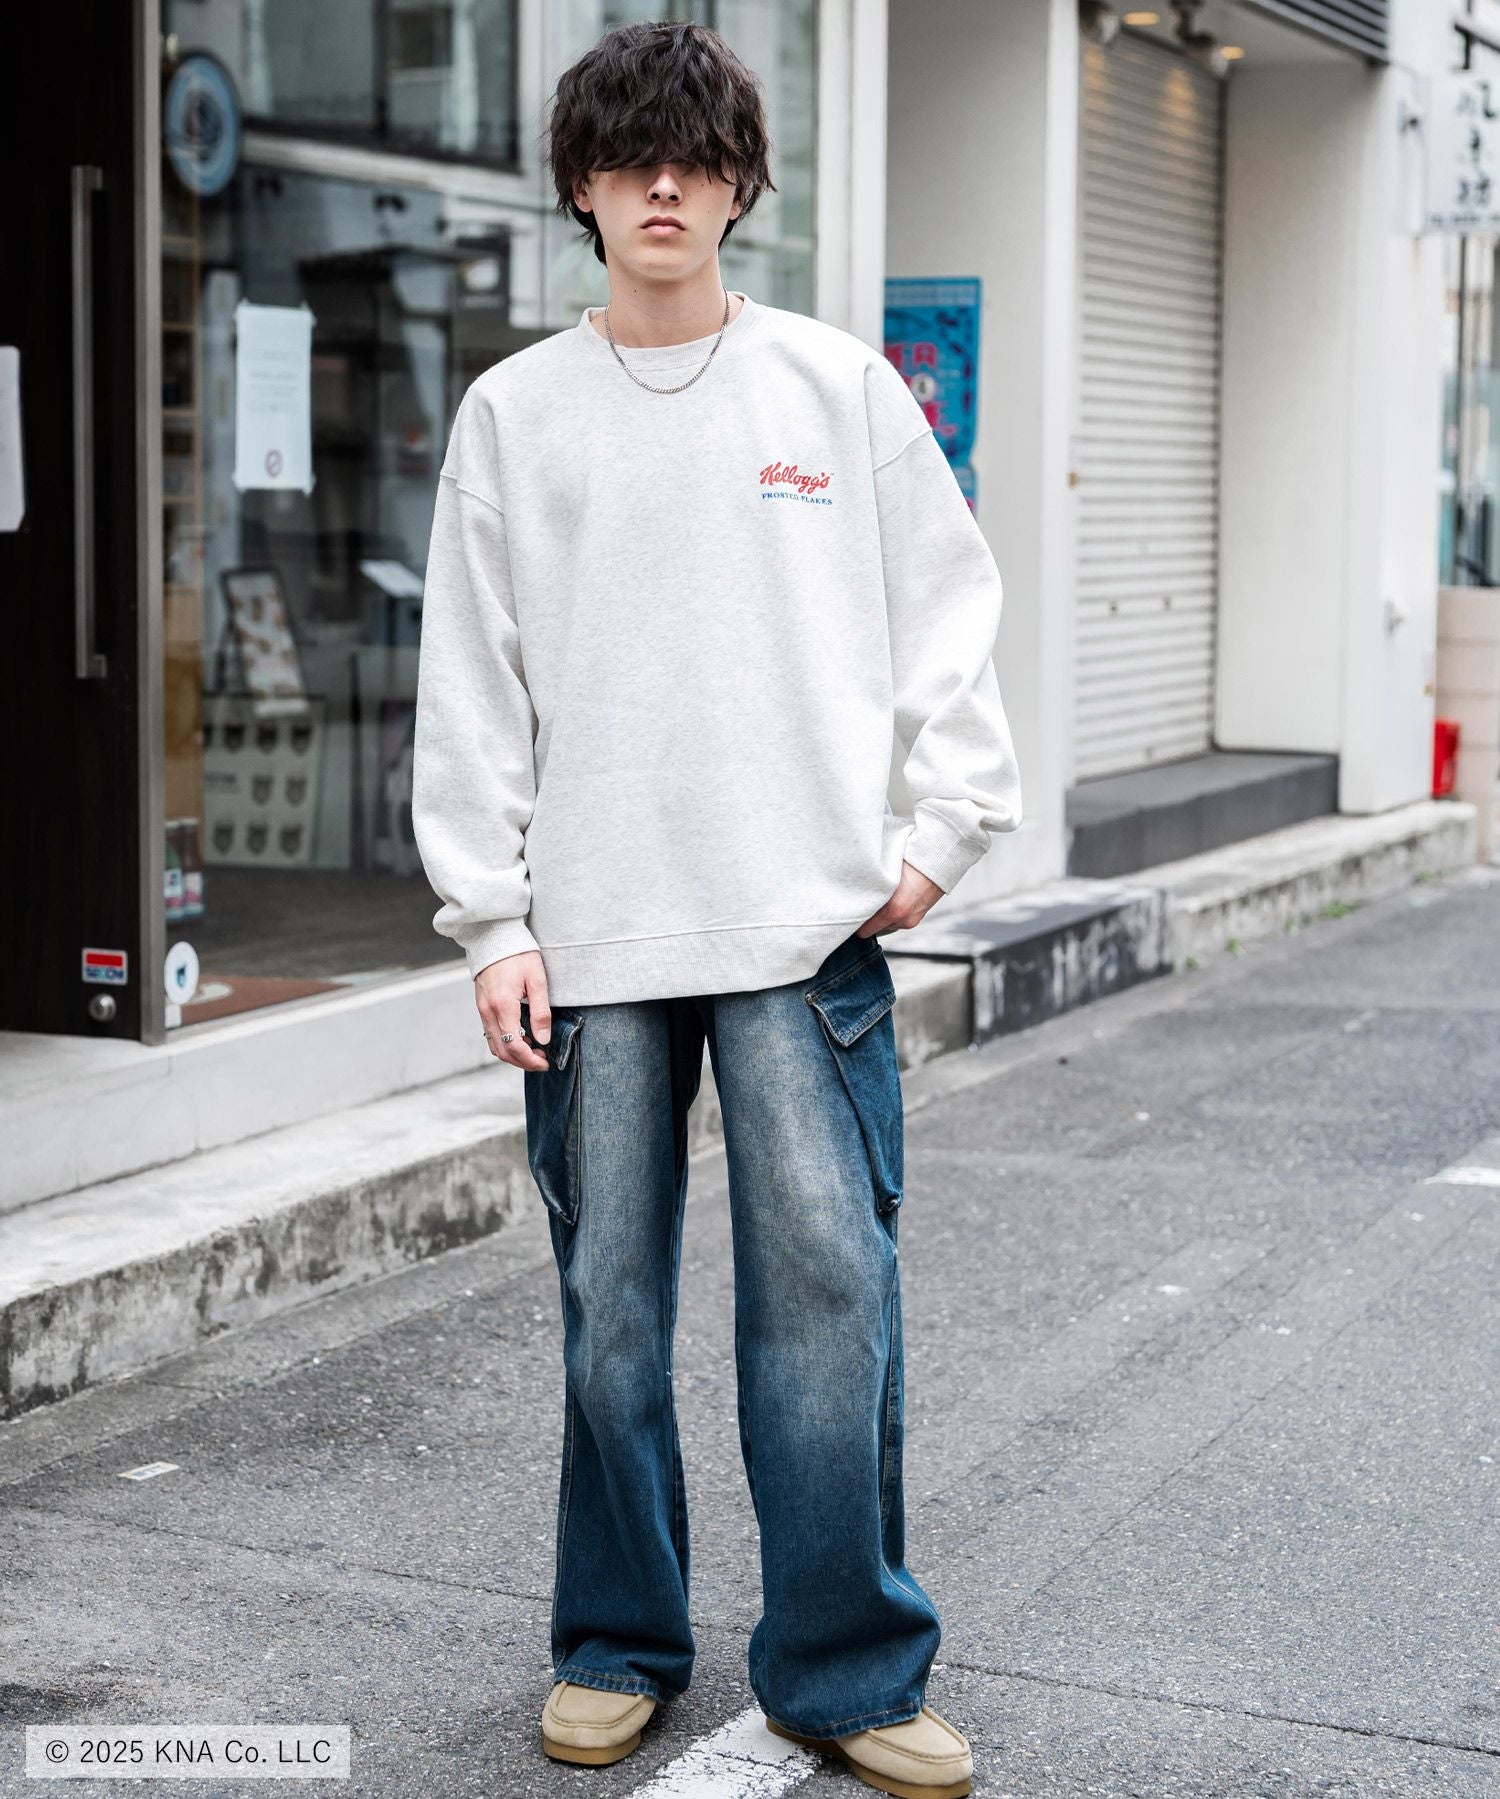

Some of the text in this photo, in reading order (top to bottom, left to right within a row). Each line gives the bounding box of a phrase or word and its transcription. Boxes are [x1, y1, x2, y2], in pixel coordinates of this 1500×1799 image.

[760, 461, 830, 494] Kellogg's
[761, 492, 833, 505] FROSTED FLAKES
